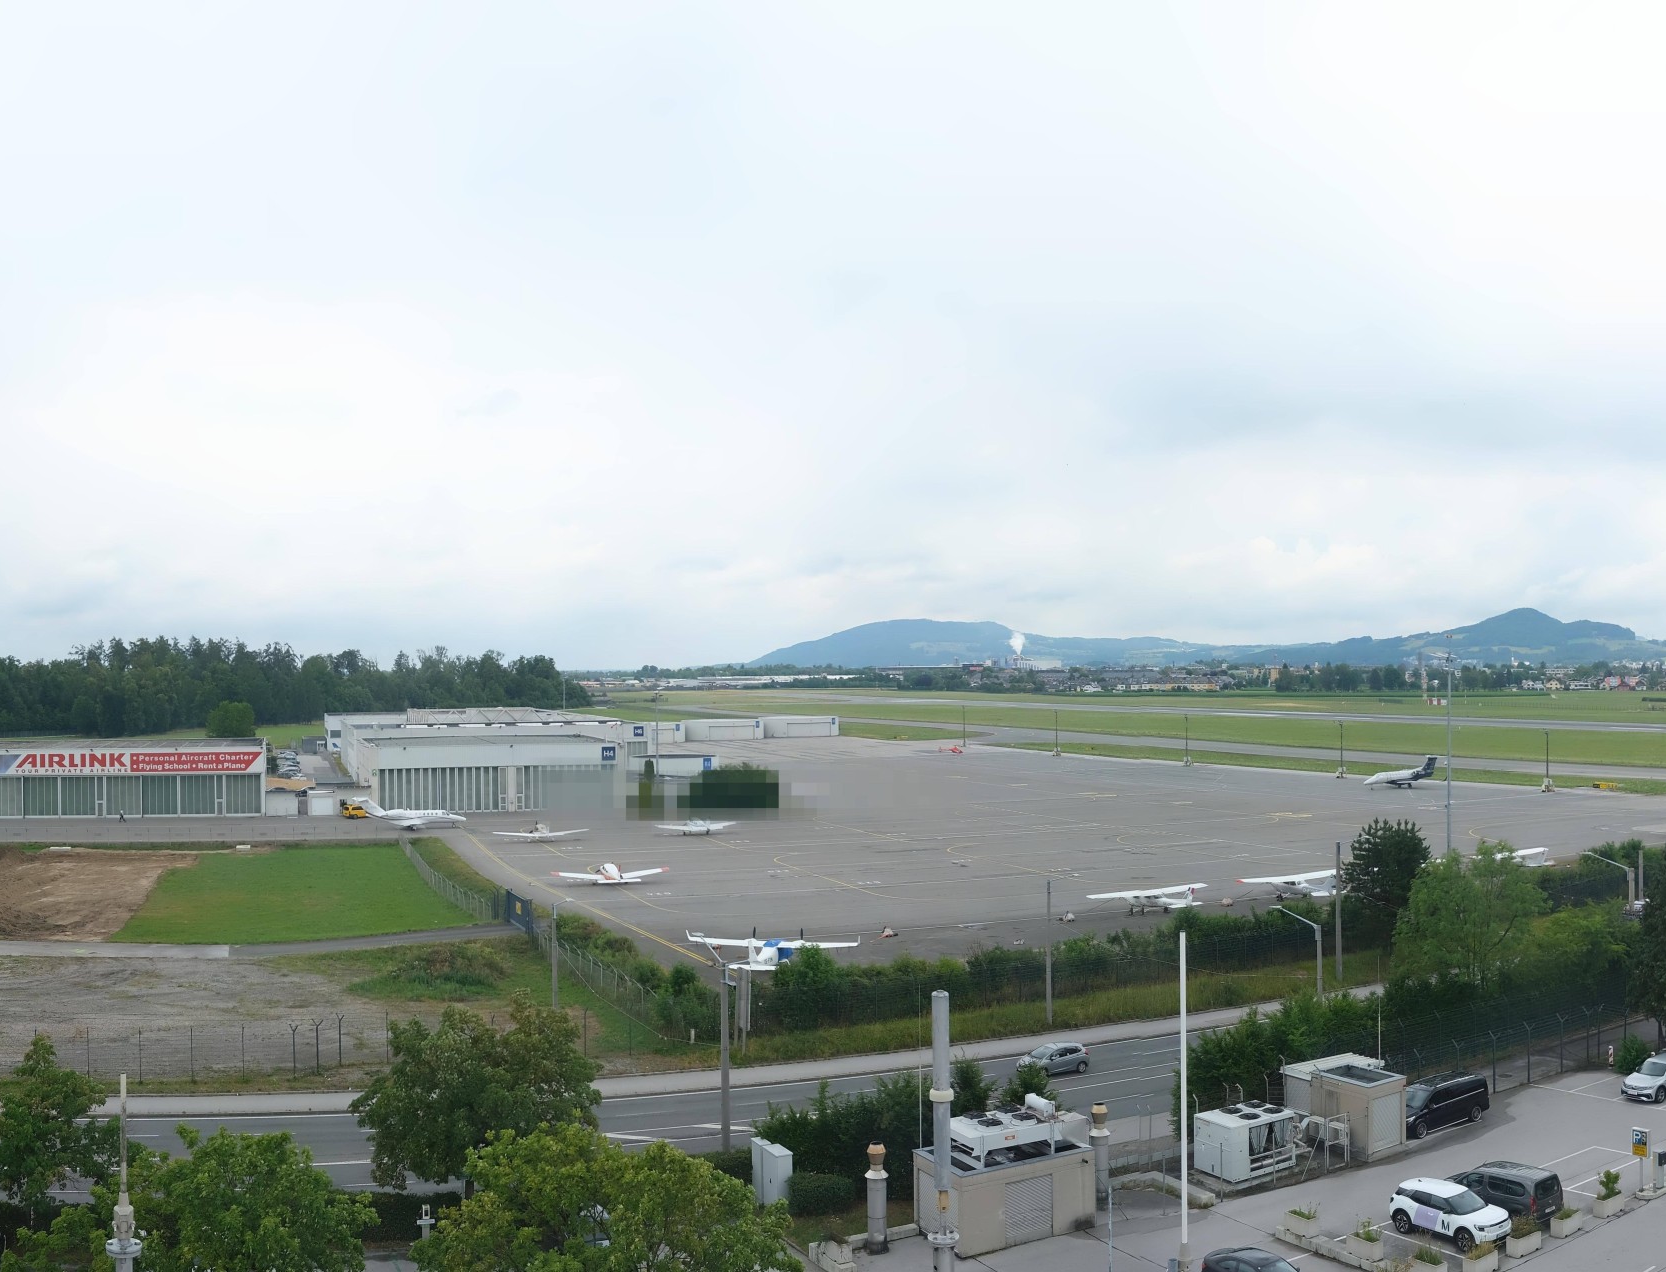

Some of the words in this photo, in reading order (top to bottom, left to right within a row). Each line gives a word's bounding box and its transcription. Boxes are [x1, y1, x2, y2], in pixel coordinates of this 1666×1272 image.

[603, 746, 614, 757] H4
[16, 753, 128, 768] AIRLINK
[139, 754, 178, 762] Personal
[139, 763, 163, 771] Flying
[1441, 1219, 1450, 1232] M
